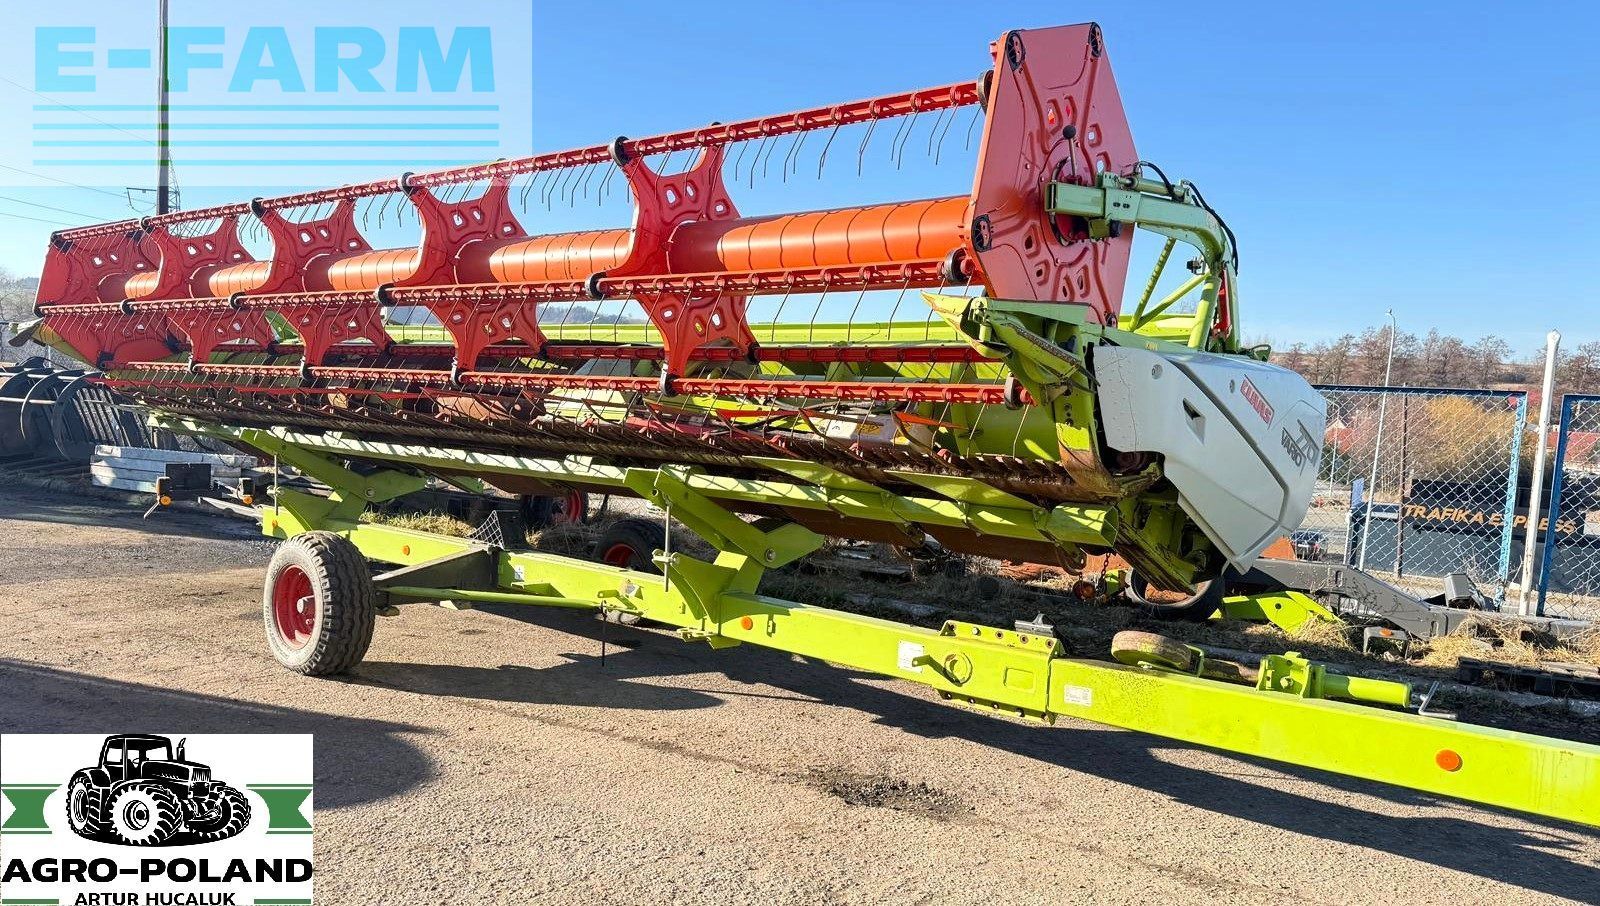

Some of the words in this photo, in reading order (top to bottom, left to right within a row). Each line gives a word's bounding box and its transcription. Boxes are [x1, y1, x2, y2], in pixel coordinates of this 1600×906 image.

[1240, 379, 1273, 424] CLAAS
[1280, 428, 1303, 468] VARIO
[1403, 504, 1485, 525] TRAFIKA
[1488, 512, 1577, 534] EPESS
